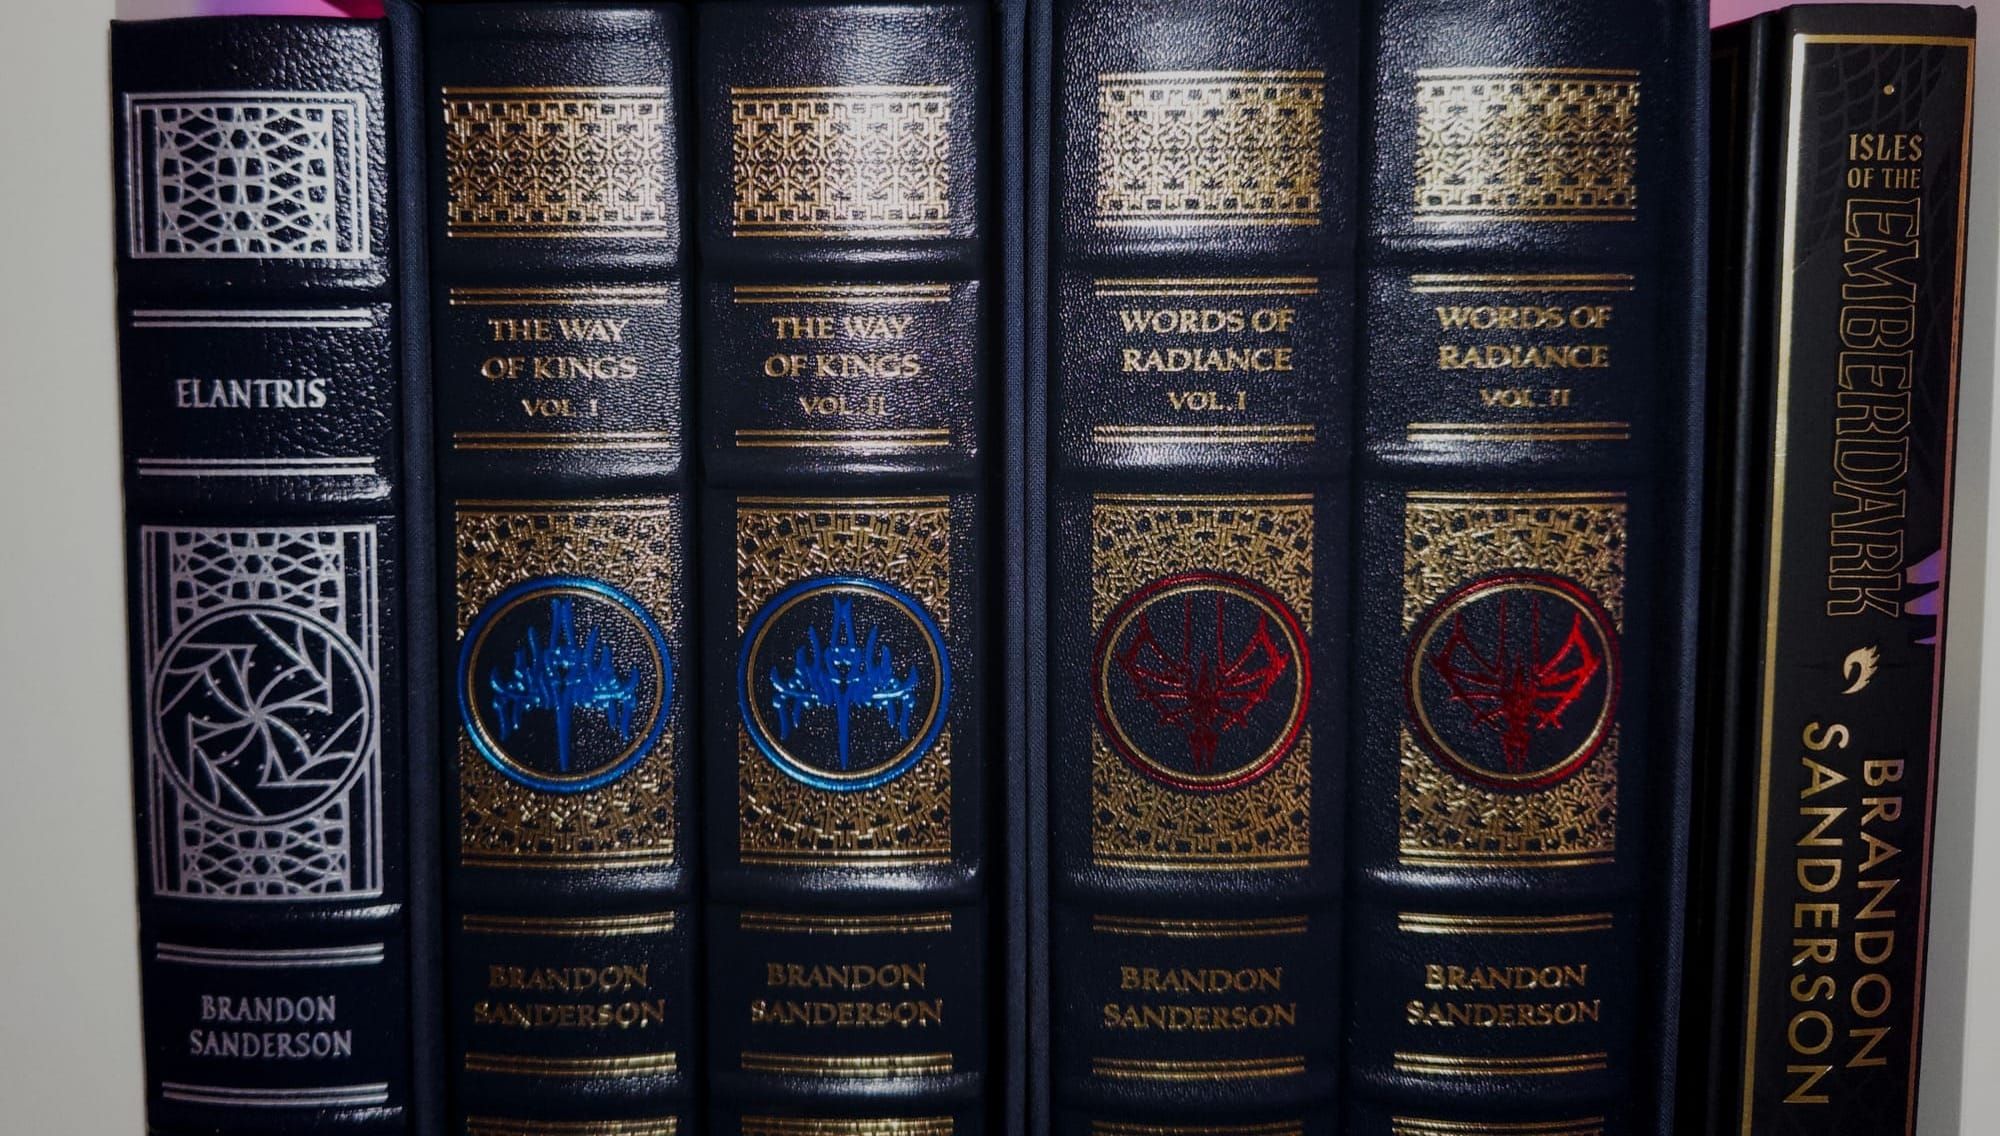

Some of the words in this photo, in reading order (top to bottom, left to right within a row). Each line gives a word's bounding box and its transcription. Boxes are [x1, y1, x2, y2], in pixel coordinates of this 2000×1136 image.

[1849, 134, 1922, 161] ISLES
[1847, 167, 1874, 189] OF
[1881, 168, 1921, 189] THE
[488, 319, 552, 341] THE
[557, 318, 630, 342] WAY
[772, 316, 832, 340] THE
[840, 316, 913, 339] WAY
[1120, 308, 1245, 334] WORDS
[1251, 308, 1296, 332] OF
[1436, 305, 1563, 330] WORDS
[1569, 305, 1613, 329] OF
[481, 355, 526, 380] OF
[532, 355, 638, 380] KINGS
[764, 353, 806, 378] OF
[814, 352, 921, 378] KINGS
[1121, 347, 1293, 372] RADIANCE
[1437, 344, 1610, 369] RADIANCE
[175, 378, 328, 409] ELANTRIS
[1237, 391, 1247, 410] I
[1550, 388, 1571, 408] II
[588, 398, 600, 417] I
[1827, 197, 1921, 618] EMBERDARK
[1783, 722, 1850, 1104] SANDERSON
[1845, 759, 1905, 1068] BRANDON
[489, 964, 648, 991] BRANDON
[766, 962, 926, 989] BRANDON
[1120, 966, 1282, 991] BRANDON
[1424, 964, 1588, 990] BRANDON
[201, 995, 336, 1023] BRANDON
[473, 999, 665, 1028] SANDERSON
[751, 998, 943, 1027] SANDERSON
[1103, 1002, 1296, 1030] SANDERSON
[1406, 999, 1600, 1027] SANDERSON
[190, 1030, 353, 1058] SANDERSON
